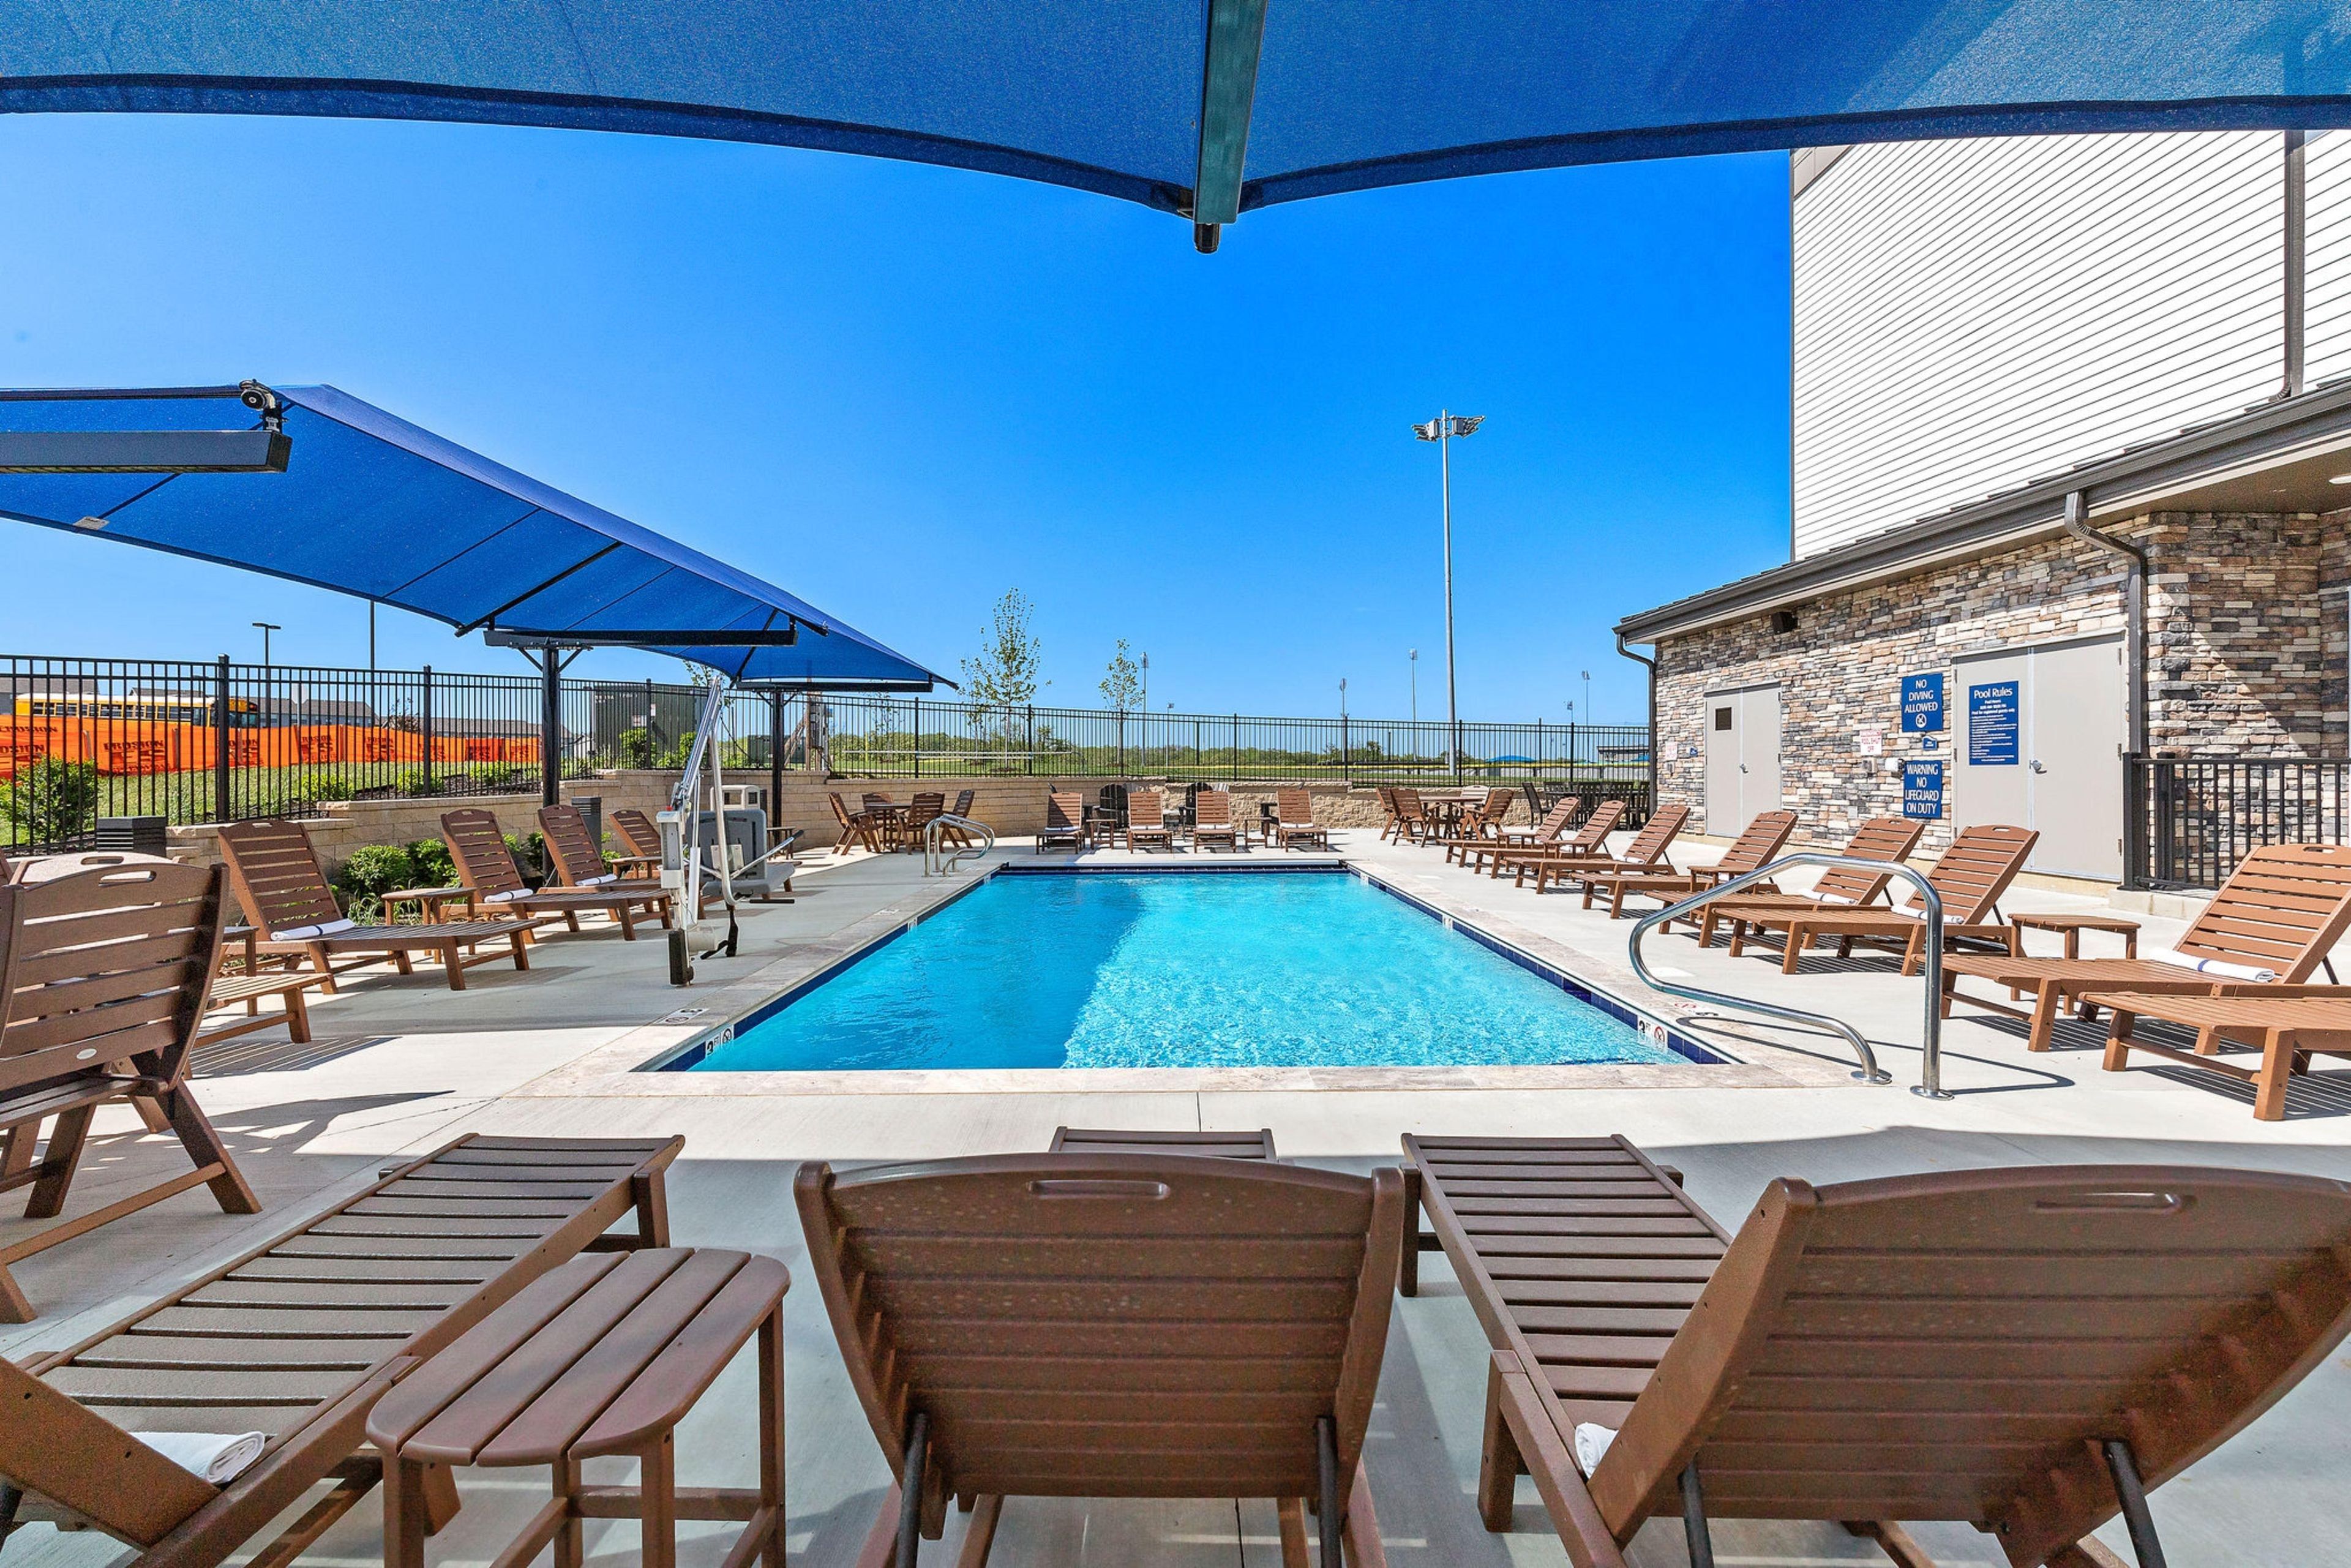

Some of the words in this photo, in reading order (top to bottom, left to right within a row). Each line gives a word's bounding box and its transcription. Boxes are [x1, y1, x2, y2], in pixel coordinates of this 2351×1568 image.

[1916, 679, 1927, 689] NO
[1908, 689, 1933, 701] DIVING
[1974, 688, 1990, 699] Pool
[1992, 686, 2013, 697] Rules
[1904, 701, 1938, 713] ALLOWED
[1906, 763, 1938, 775] WARNING
[1916, 776, 1927, 788] NO
[1905, 789, 1940, 801] LIFEGUARD
[1907, 802, 1916, 813] ON
[1918, 802, 1937, 814] DUTY
